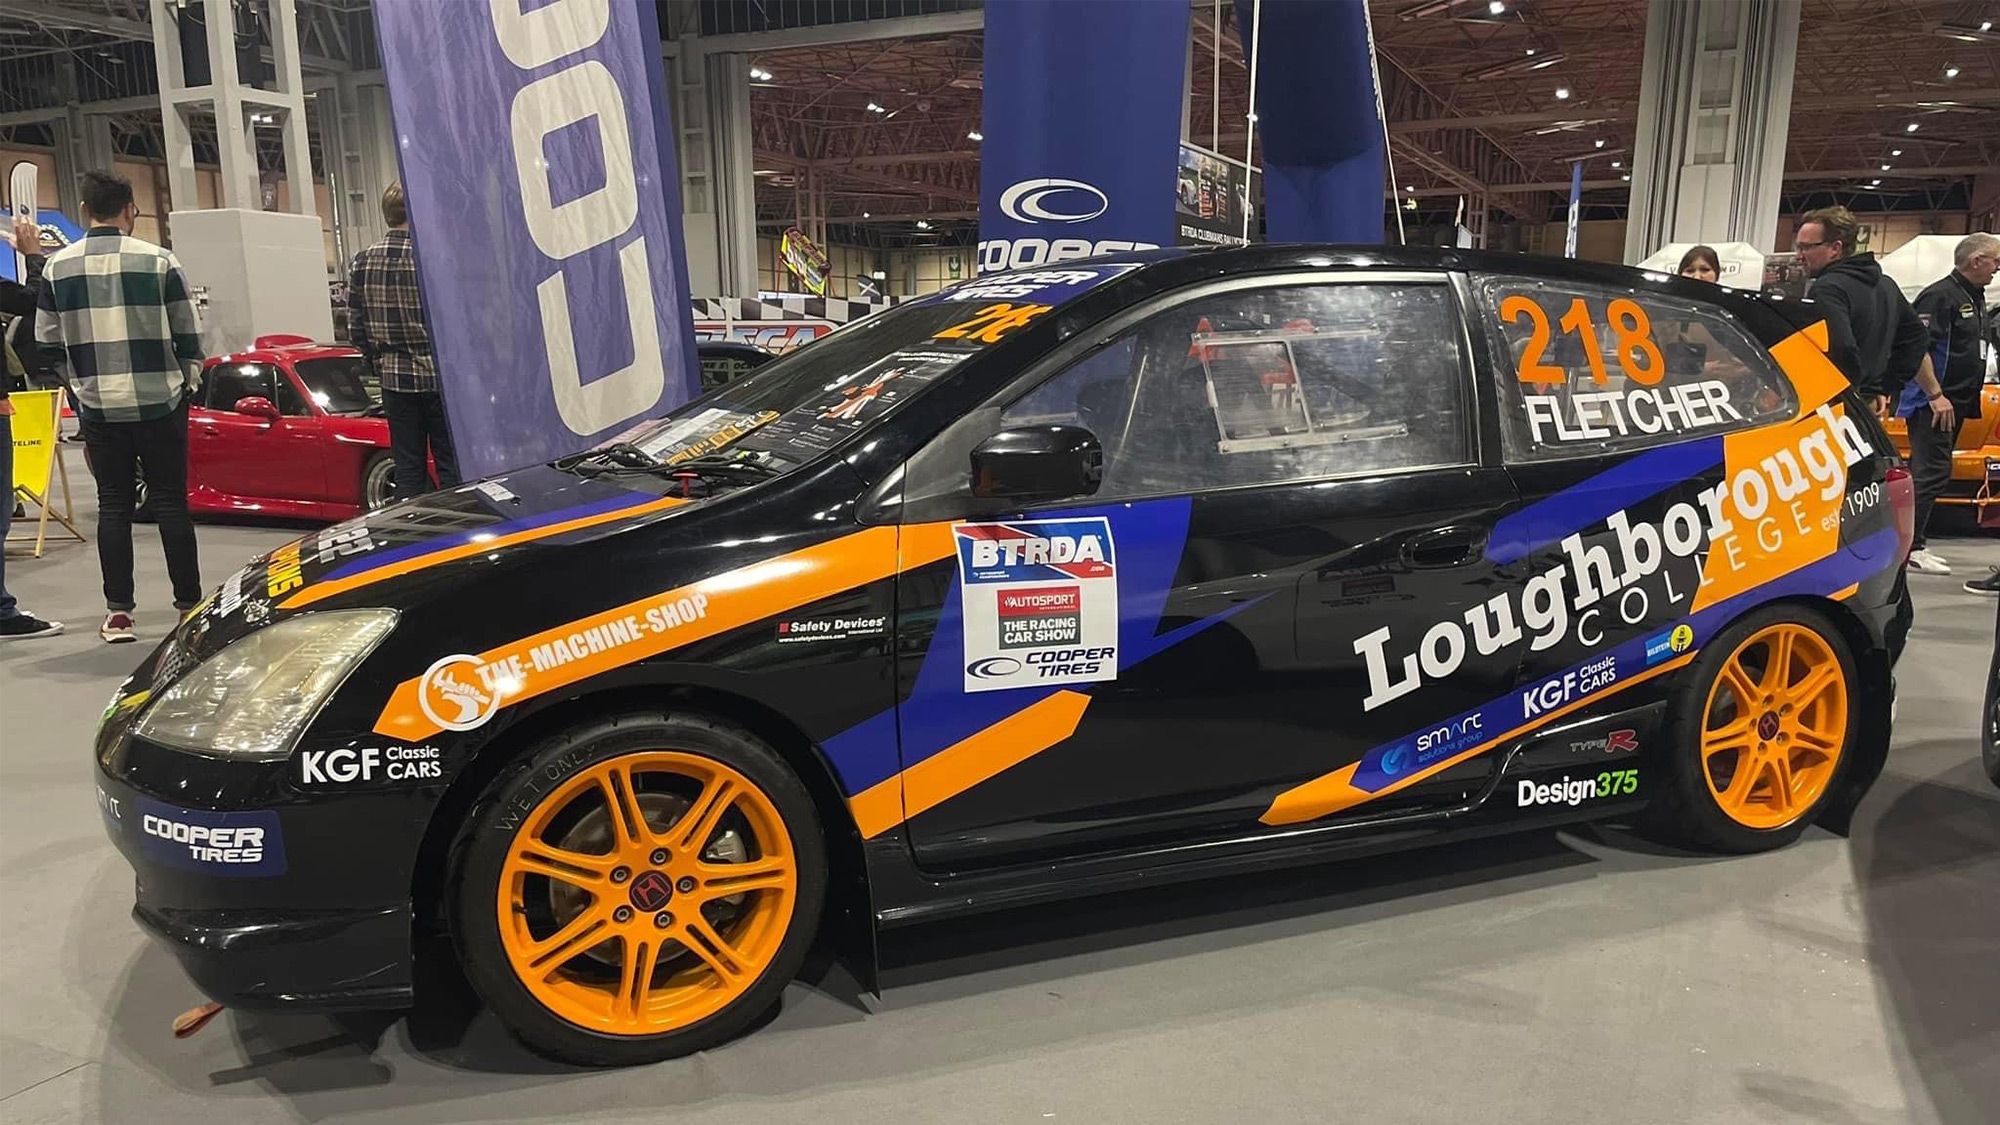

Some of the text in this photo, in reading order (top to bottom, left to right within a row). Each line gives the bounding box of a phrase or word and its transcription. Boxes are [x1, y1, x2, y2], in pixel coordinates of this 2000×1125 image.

[1500, 295, 1665, 386] 218
[1524, 380, 1742, 442] FLETCHER
[1821, 482, 1879, 531] est. 1909
[972, 535, 1104, 568] BTRDA
[1353, 403, 1874, 712] Loughborough
[1577, 501, 1812, 647] COLLEGE
[1005, 593, 1075, 608] AUTOSPORT
[790, 617, 885, 633] Safety Devices
[1004, 618, 1077, 632] THE RACING
[1004, 629, 1076, 644] CAR SHOW
[779, 634, 846, 642] www.safetydevices.com
[1647, 641, 1670, 657] BILSTEIN
[1026, 647, 1115, 665] COOPER
[1579, 656, 1615, 678] Classic
[1038, 661, 1101, 677] TIRES
[1579, 669, 1616, 694] CARS
[1523, 672, 1576, 719] KGF
[386, 745, 440, 760] Classic
[302, 748, 380, 783] KGF
[387, 761, 441, 780] CARS
[496, 743, 596, 832] WET ONLY
[1518, 769, 1638, 807] Design375
[143, 814, 264, 848] COOPER
[189, 846, 262, 863] TIRES
